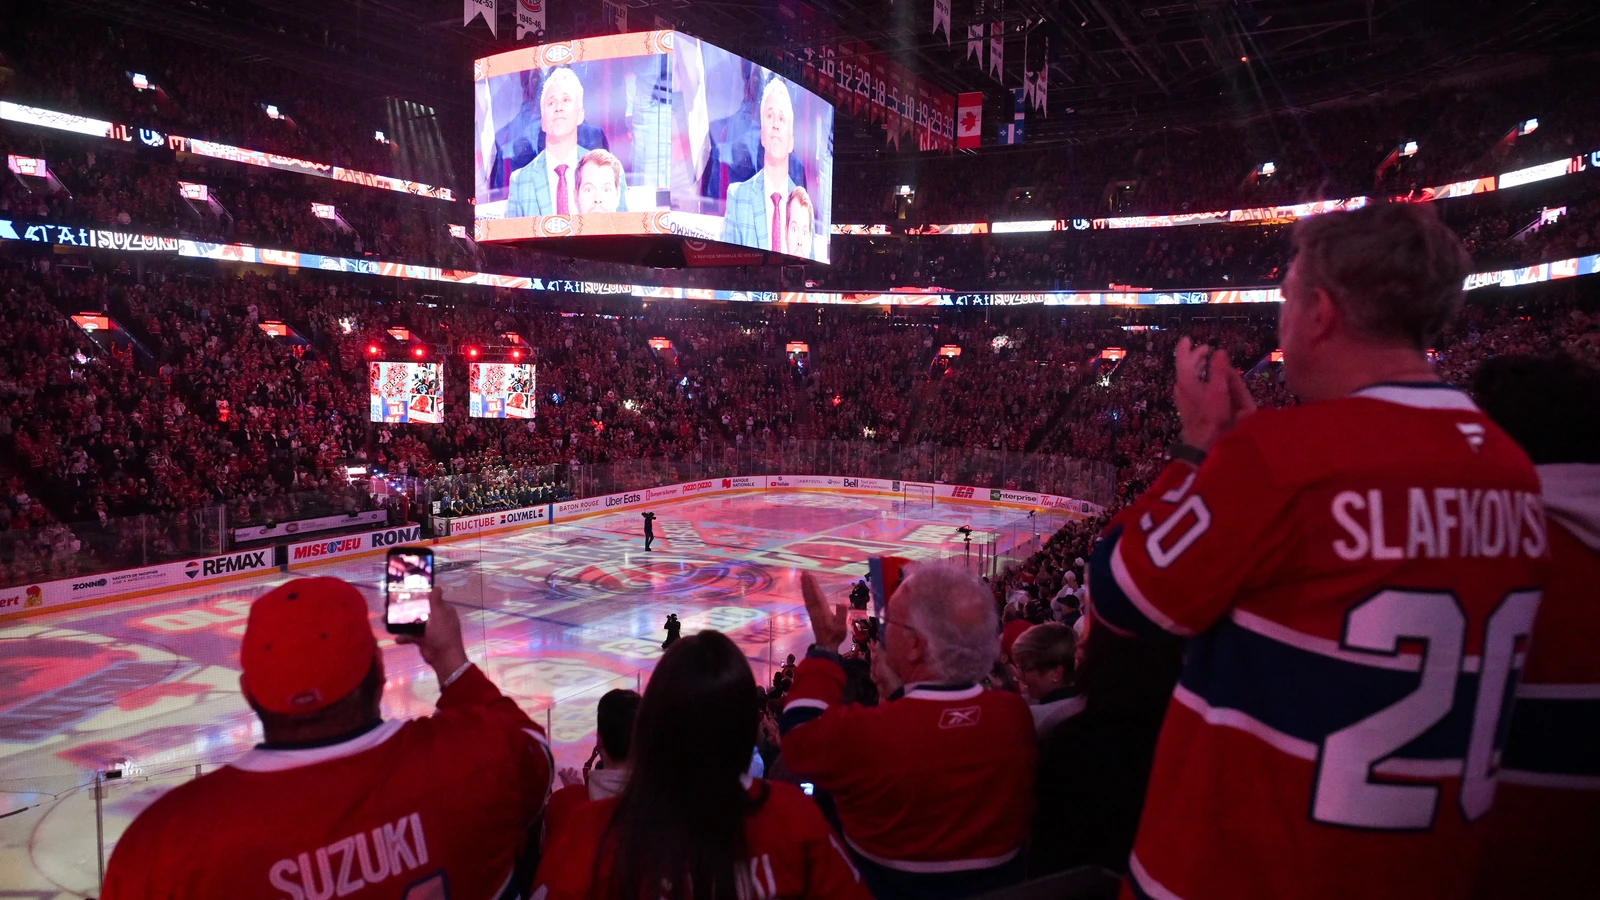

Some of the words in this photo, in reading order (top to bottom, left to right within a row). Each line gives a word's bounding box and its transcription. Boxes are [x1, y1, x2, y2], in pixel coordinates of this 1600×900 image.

[519, 13, 542, 29] 1945-46
[818, 45, 836, 78] 16
[837, 60, 853, 93] 12
[855, 67, 871, 99] 29
[872, 77, 886, 108] 18
[902, 94, 915, 121] 10
[916, 101, 928, 129] 19
[843, 478, 859, 488] Bell
[580, 499, 599, 509] ROUGE
[605, 496, 623, 507] Uber
[623, 493, 641, 504] Eats
[1040, 495, 1054, 508] Tim
[507, 510, 537, 523] OLYMEL
[1330, 486, 1546, 560] SLAFKOVS
[371, 526, 421, 548] RONA
[268, 812, 430, 900] SUZUKI
